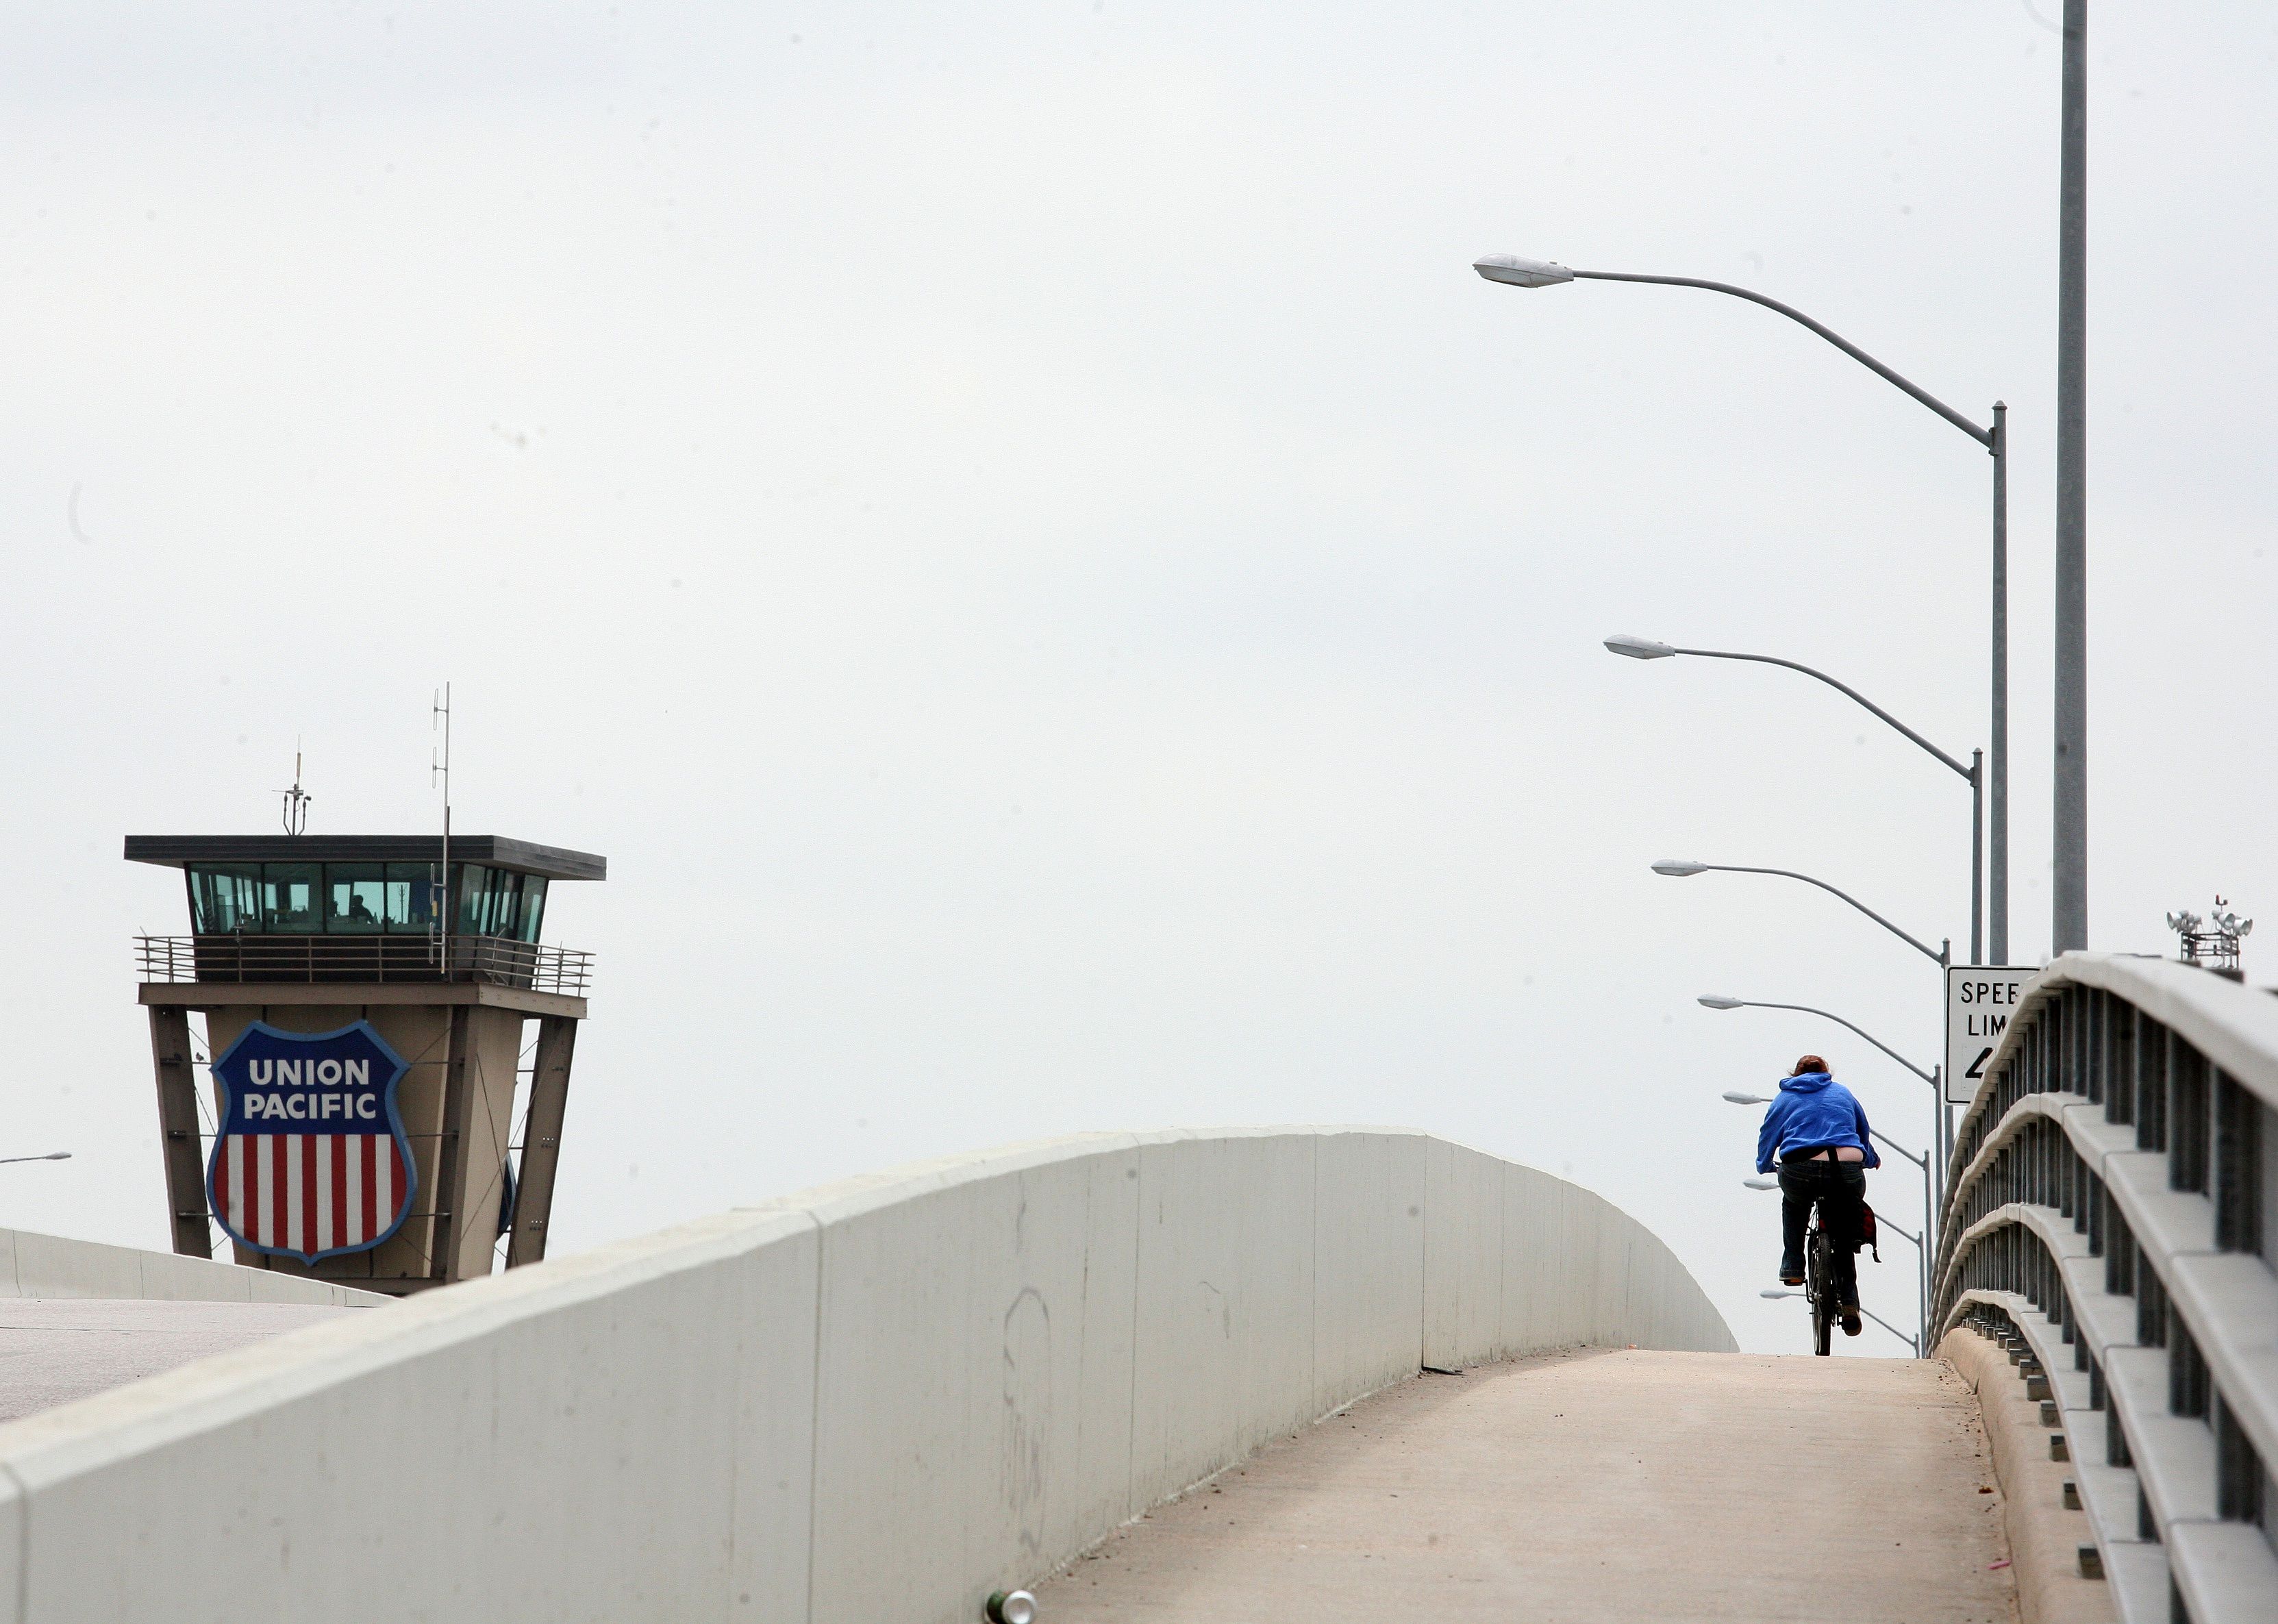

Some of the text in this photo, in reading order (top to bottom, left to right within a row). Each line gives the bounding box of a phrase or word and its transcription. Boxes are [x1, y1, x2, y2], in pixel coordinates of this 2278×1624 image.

[1961, 982, 2019, 1004] SPEE
[1968, 1014, 2007, 1036] LIM
[249, 1059, 369, 1085] UNION
[244, 1093, 376, 1119] PACIFIC
